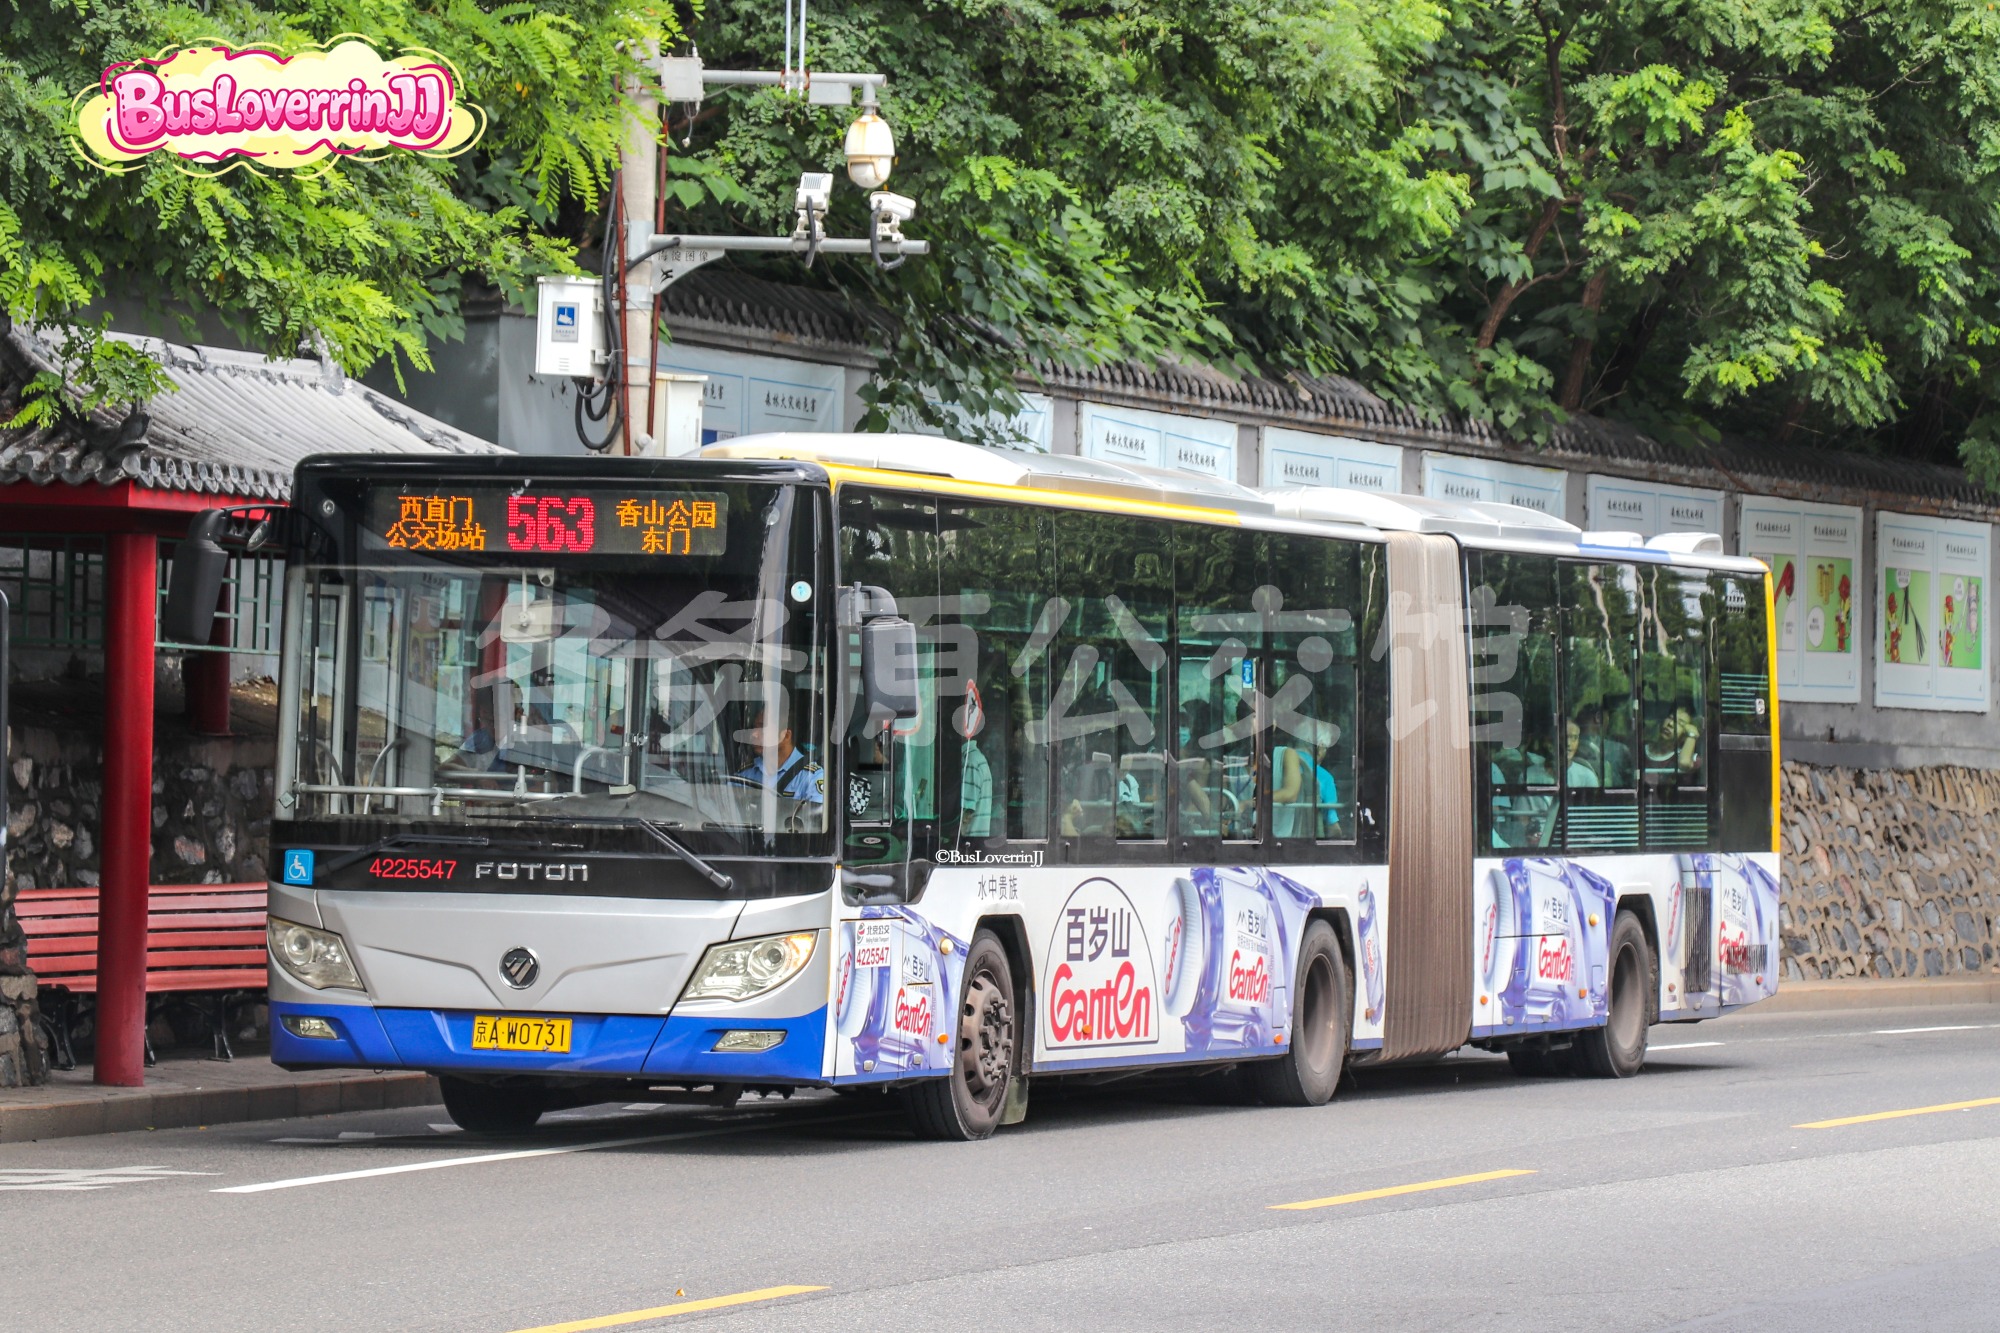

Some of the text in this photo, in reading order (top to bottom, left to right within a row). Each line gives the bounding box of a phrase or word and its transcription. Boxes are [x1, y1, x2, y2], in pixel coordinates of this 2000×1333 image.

[398, 495, 473, 523] 西直门
[507, 496, 595, 551] 563
[615, 498, 717, 529] 香山公园
[385, 521, 487, 551] 公交场站
[640, 526, 691, 555] 东门
[369, 858, 457, 879] 4225547
[475, 862, 588, 881] FOTON
[977, 874, 1018, 900] 水中贵族
[866, 924, 890, 935] 北京公交
[1066, 906, 1131, 962] 百岁山
[1247, 908, 1267, 938] 百岁山
[857, 946, 890, 966] 4225547
[912, 954, 930, 982] 百岁山
[1539, 935, 1571, 981] Ganten
[1229, 949, 1268, 1003] Ganten
[895, 987, 931, 1037] Ganten
[1051, 961, 1150, 1042] Ganten
